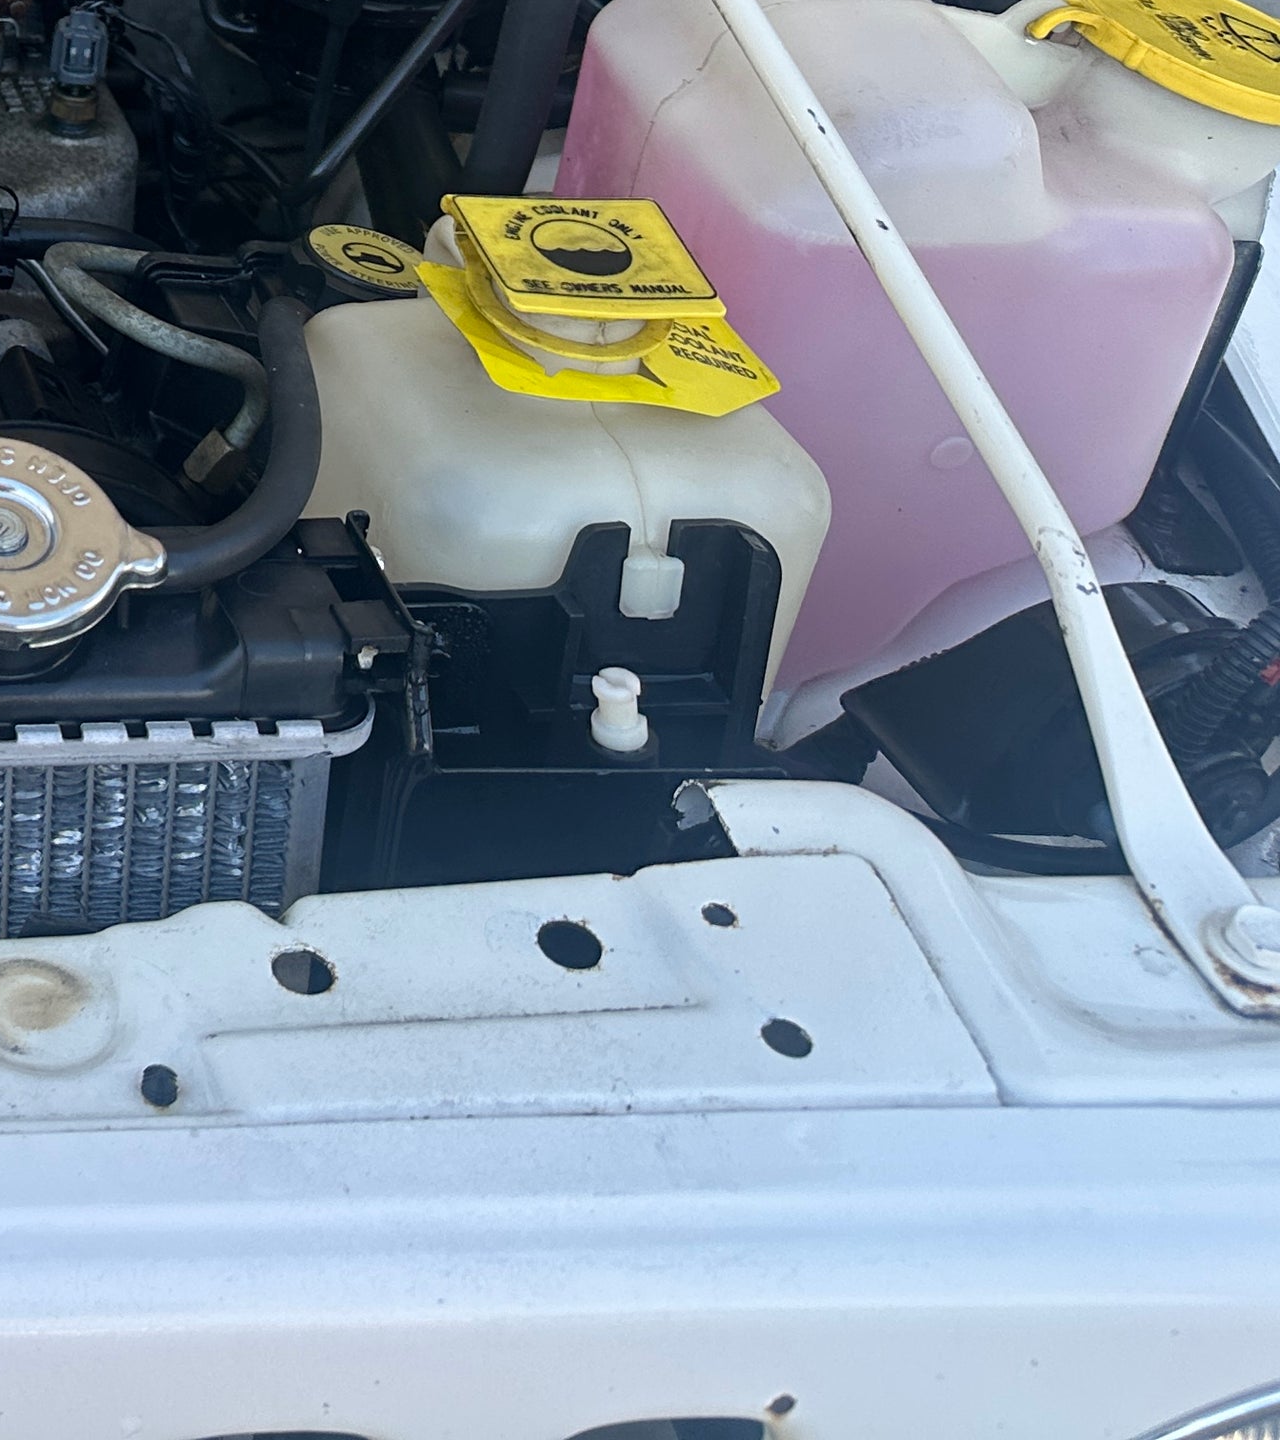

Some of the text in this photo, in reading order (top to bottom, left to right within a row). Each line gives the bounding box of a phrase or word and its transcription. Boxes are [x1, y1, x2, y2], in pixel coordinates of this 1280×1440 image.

[531, 205, 599, 219] COOLANT
[608, 218, 643, 241] ONLY
[346, 227, 416, 254] APPROVED
[349, 269, 419, 289] STEERING
[522, 278, 693, 294] SEE OWNERS MANUAL
[668, 333, 746, 364] OOLANT
[668, 344, 757, 380] REQUIRED
